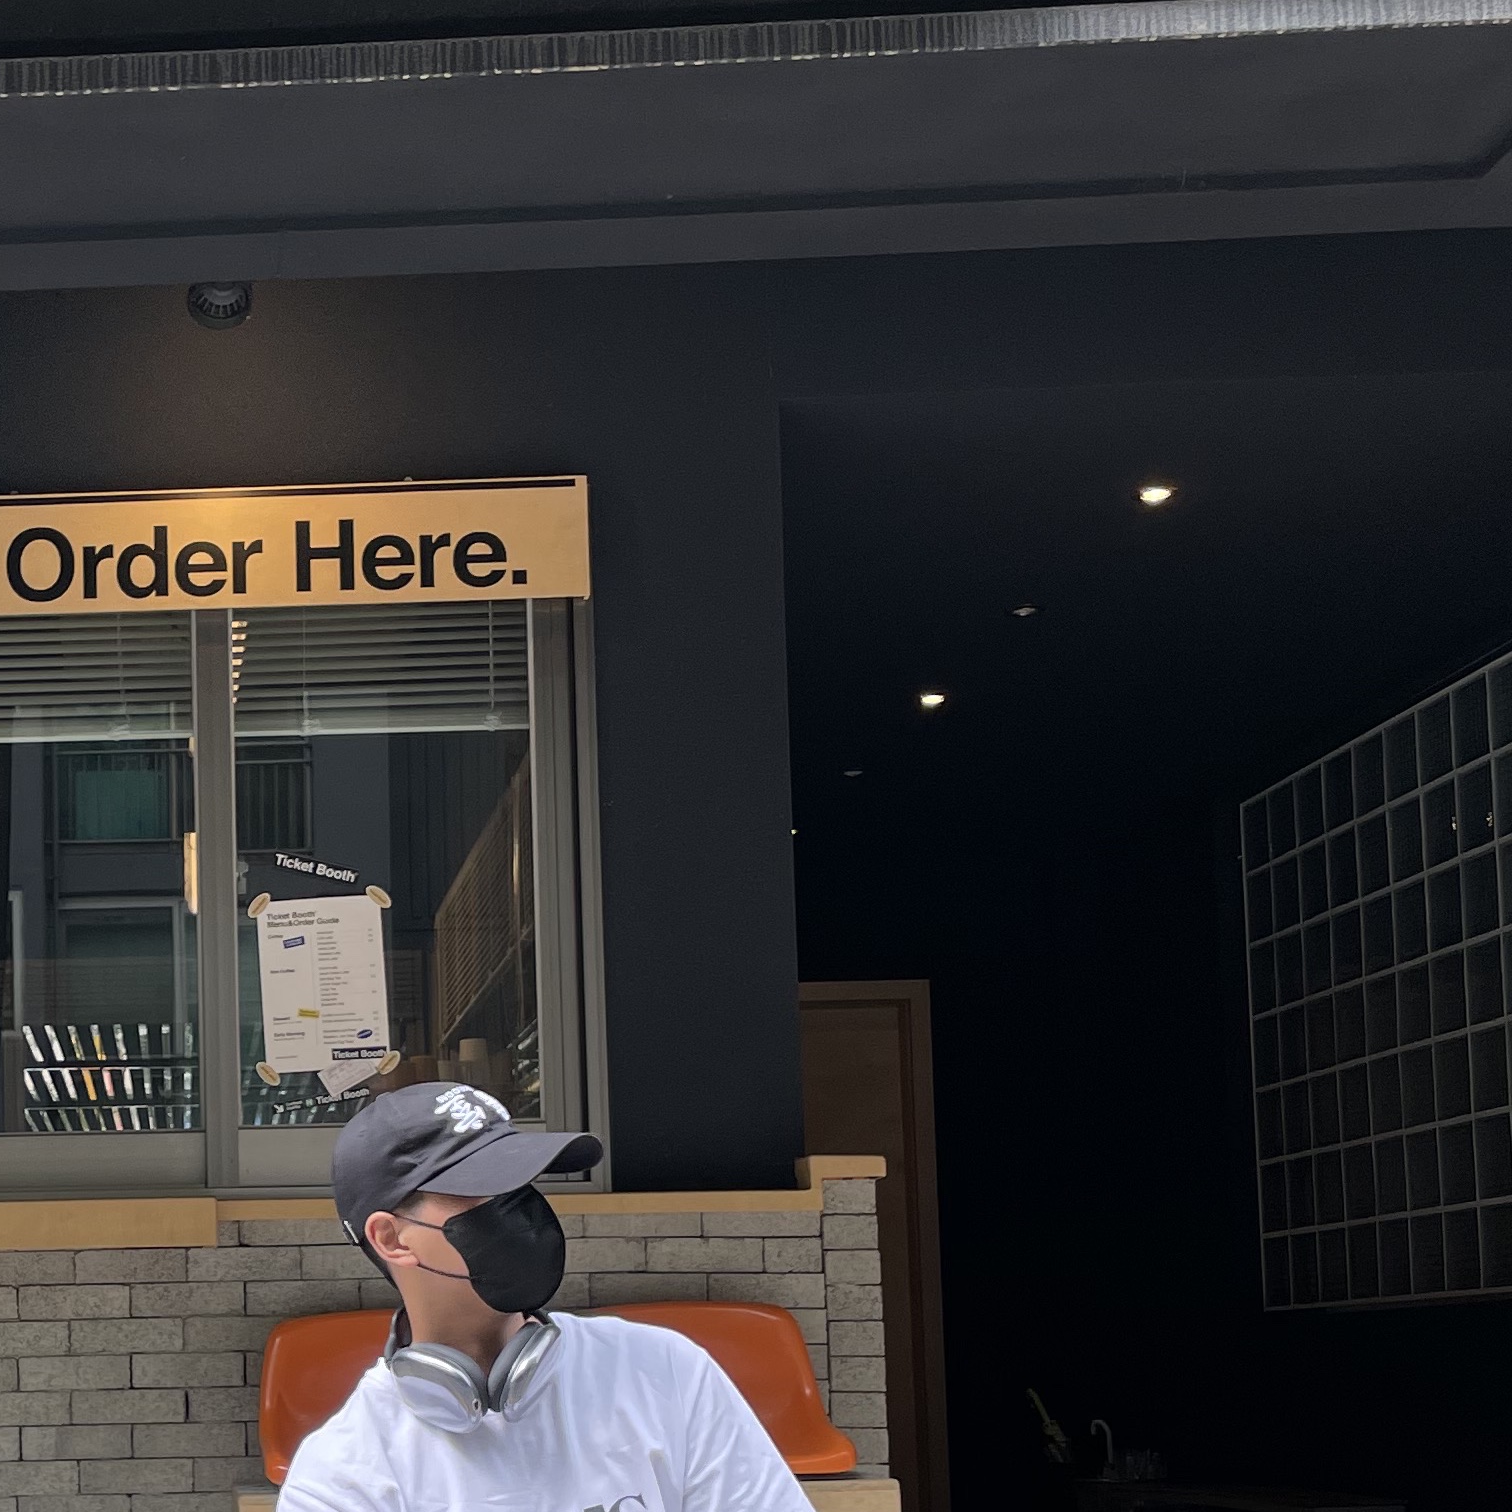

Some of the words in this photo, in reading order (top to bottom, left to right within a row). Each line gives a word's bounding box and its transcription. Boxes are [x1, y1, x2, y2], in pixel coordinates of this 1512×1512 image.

[6, 525, 263, 602] Order
[295, 518, 528, 592] Here.
[275, 853, 315, 873] Ticket
[315, 863, 358, 883] Booth
